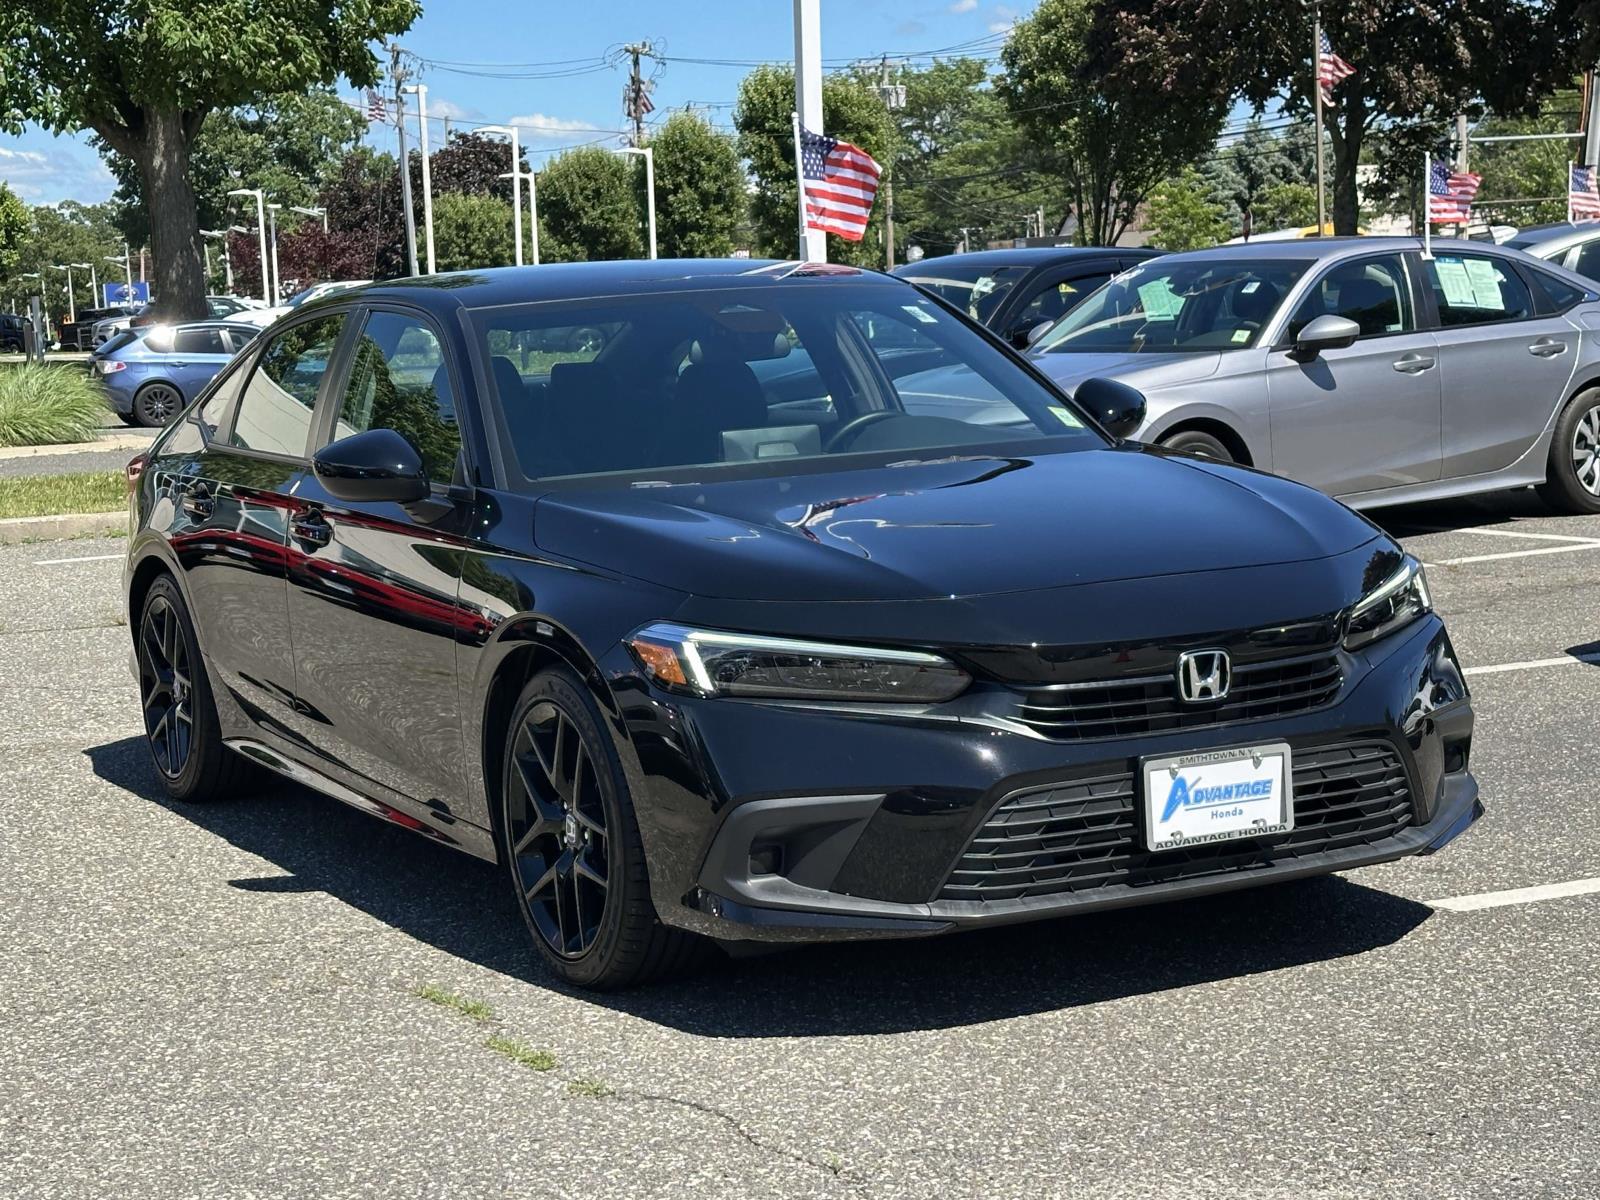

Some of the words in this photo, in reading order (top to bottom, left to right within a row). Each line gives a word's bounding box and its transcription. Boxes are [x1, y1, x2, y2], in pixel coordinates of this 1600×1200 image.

[1160, 776, 1273, 823] ADVANTAGE
[1211, 807, 1243, 819] Honda
[1155, 831, 1236, 849] ADVANTAGE
[1239, 824, 1287, 836] HONDA
